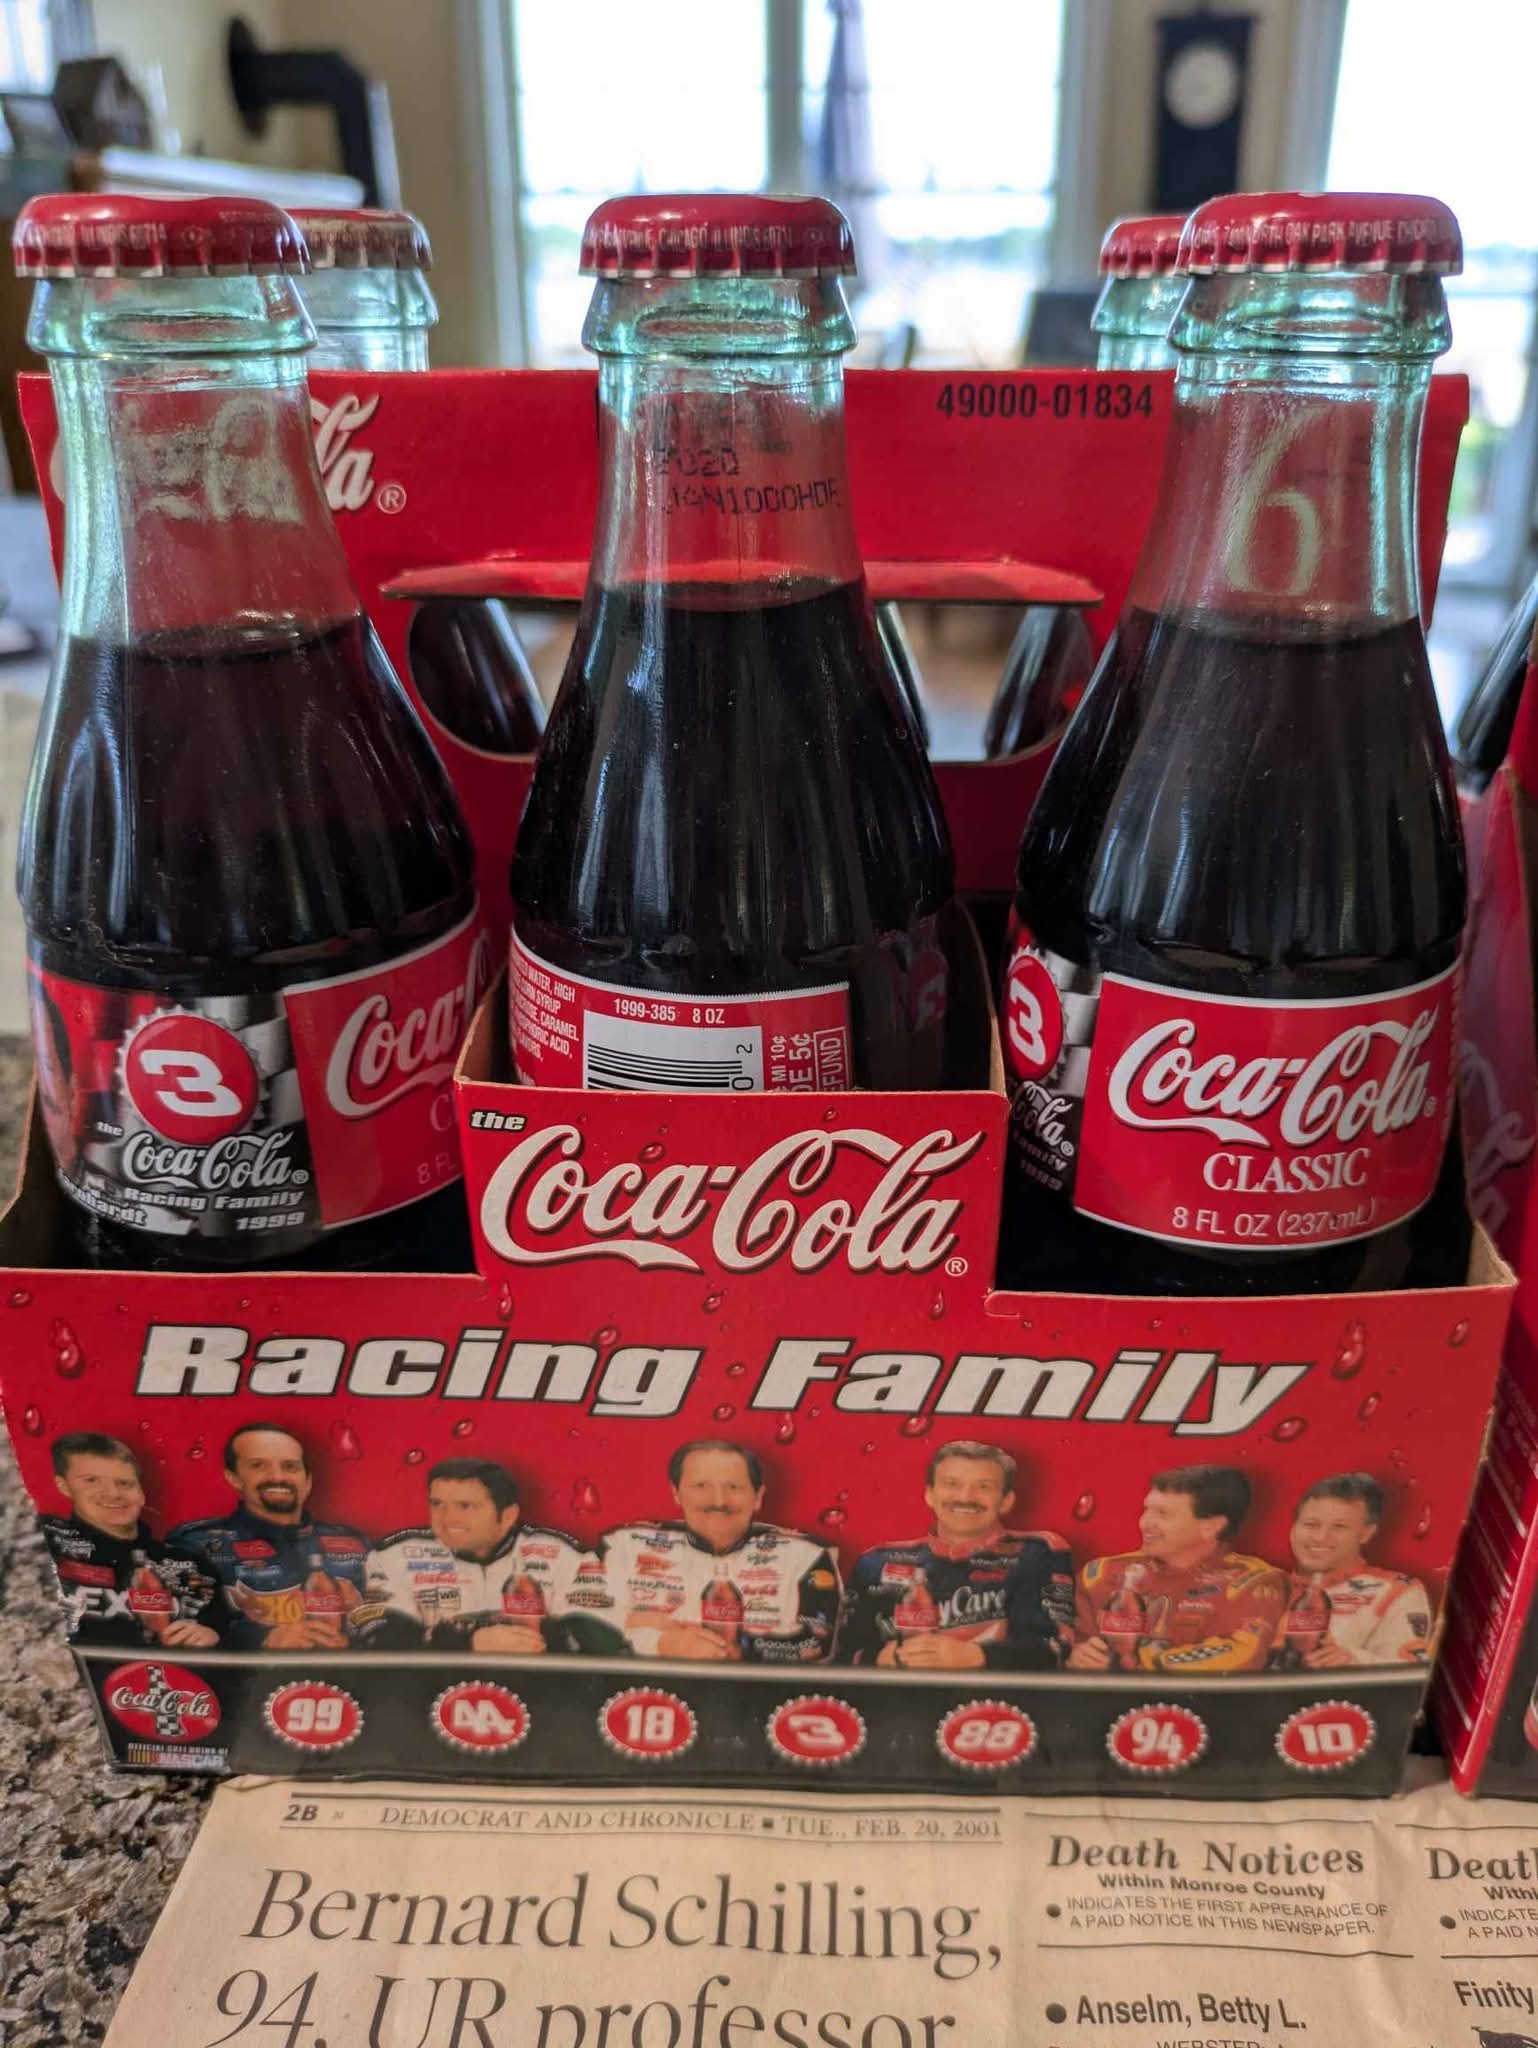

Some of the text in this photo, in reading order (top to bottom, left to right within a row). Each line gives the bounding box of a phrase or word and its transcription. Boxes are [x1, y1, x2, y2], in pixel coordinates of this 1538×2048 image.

[937, 383, 1153, 418] 49000-01834
[536, 990, 562, 1015] SYRUP
[554, 980, 576, 1003] HIGH
[540, 1011, 580, 1042] CARAMEL
[614, 998, 725, 1025] 1999-385 8 OZ
[1009, 977, 1047, 1065] 3
[550, 1034, 573, 1060] ACID,
[736, 1043, 753, 1054] 2
[789, 1032, 816, 1061] 5¢
[141, 1050, 243, 1117] 3
[771, 1065, 787, 1083] MI
[1108, 1003, 1438, 1147] Coca-Cola
[96, 1121, 124, 1136] the
[470, 1109, 527, 1131] the
[122, 1131, 295, 1190] Coca-Cola
[1202, 1147, 1371, 1193] CLASSIC
[123, 1186, 304, 1211] Racing Family
[481, 1124, 986, 1273] Coca-Cola
[235, 1211, 305, 1231] 1999
[1171, 1206, 1189, 1229] 8
[1195, 1208, 1225, 1234] FL
[1234, 1213, 1271, 1237] OZ
[135, 1323, 1314, 1437] Racing Family
[111, 1685, 214, 1717] Coca-Cola
[287, 1698, 342, 1733] 99
[626, 1705, 675, 1744] 18
[788, 1714, 845, 1747] 3
[953, 1719, 1021, 1750] 88
[1131, 1717, 1183, 1760] 94
[1299, 1723, 1354, 1754] 10
[283, 1804, 319, 1822] 2B
[380, 1806, 529, 1829] DEMOCRAT
[535, 1810, 592, 1828] AND
[600, 1810, 754, 1831] CHRONICLE
[855, 1819, 906, 1837] FEB.
[913, 1820, 945, 1840] 20,
[952, 1820, 1001, 1838] 2001
[1048, 1834, 1365, 1876] Death Notices
[1097, 1873, 1326, 1900] Within Monroe County
[1067, 1896, 1388, 1919] INDICATES THE FIRST APPEARANCE OF
[1458, 1908, 1538, 1922] INDICATE
[241, 1867, 1003, 1981] Bernard Schilling,
[1070, 1913, 1376, 1937] A PAID NOTICE IN THIS NEWSPAPER.
[1467, 1926, 1480, 1938] A
[1483, 1925, 1524, 1939] PAID
[370, 1974, 507, 2048] UR
[537, 1975, 956, 2048] professor
[1077, 1992, 1308, 2033] Anselm, Betty L.
[1453, 1979, 1535, 2015] Finity
